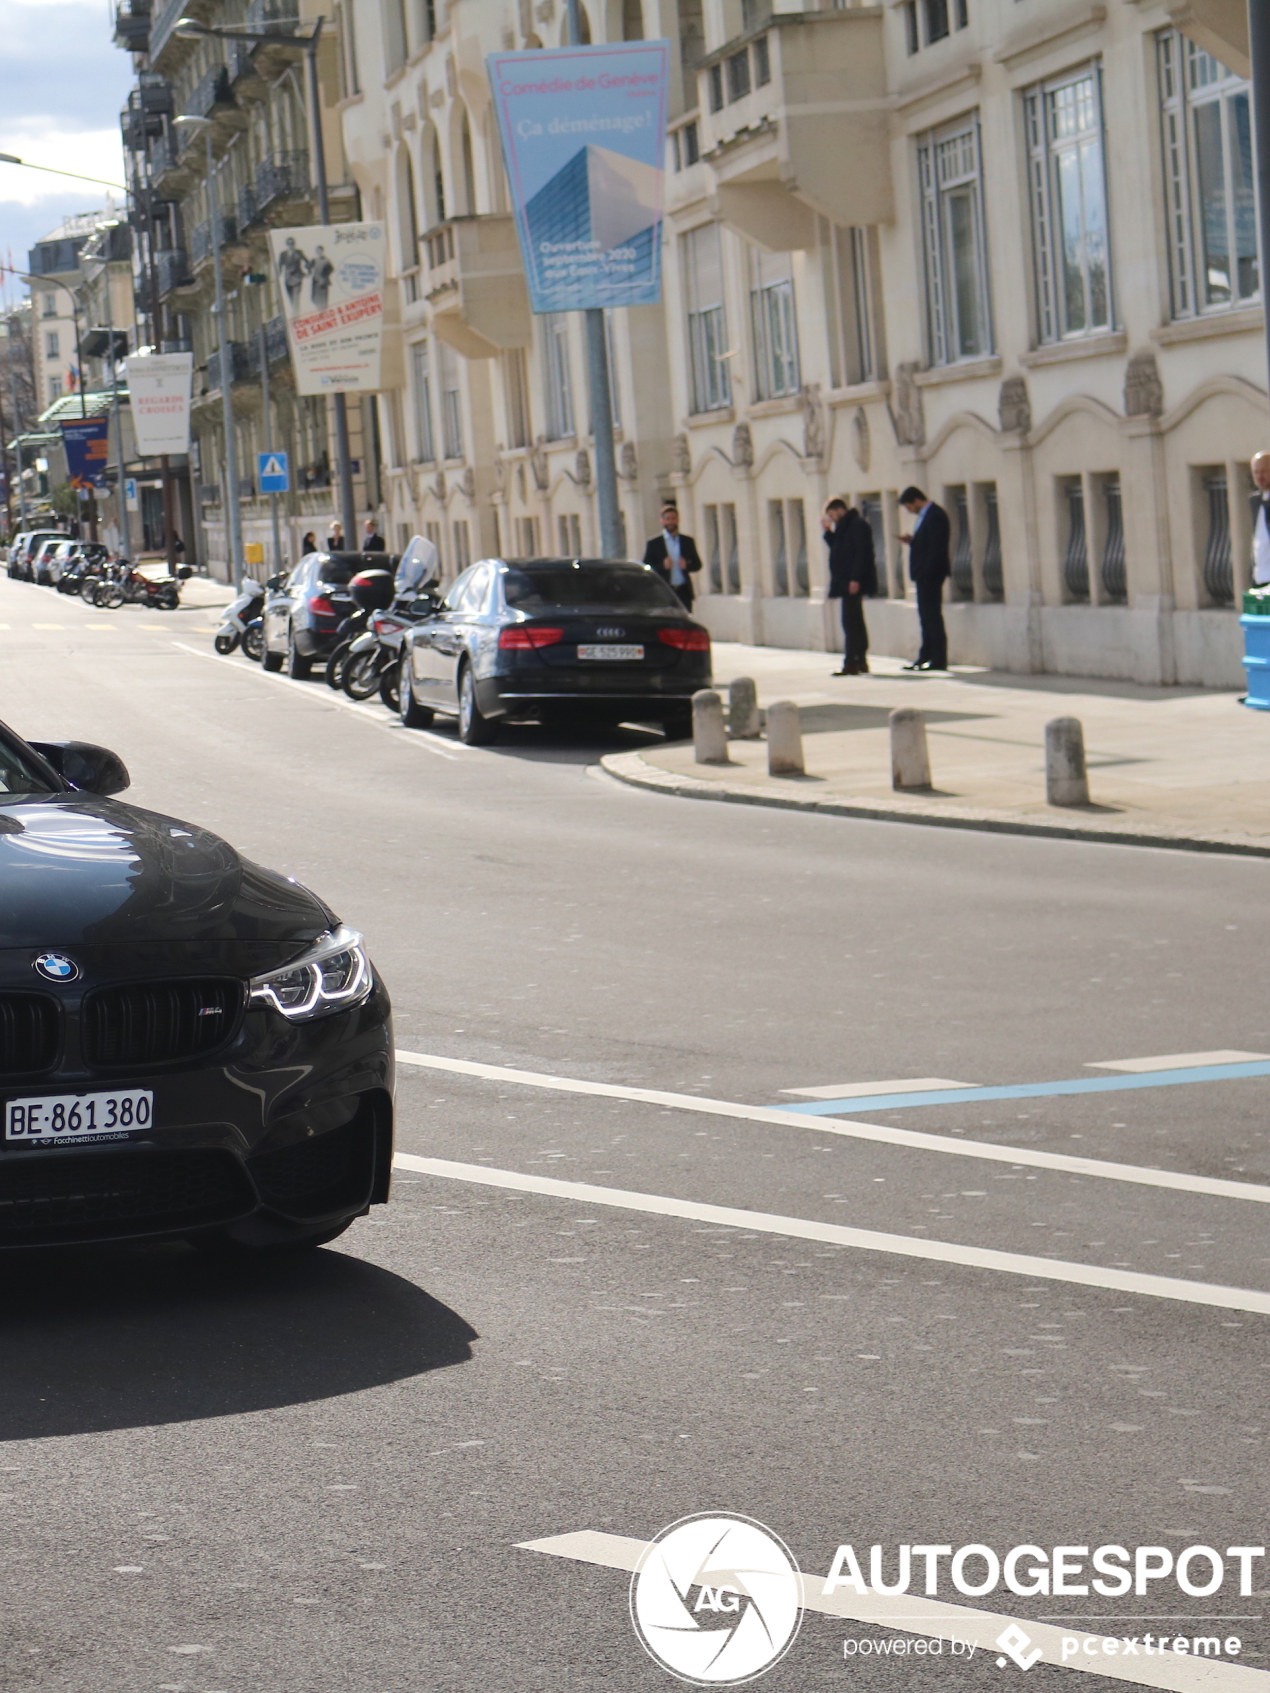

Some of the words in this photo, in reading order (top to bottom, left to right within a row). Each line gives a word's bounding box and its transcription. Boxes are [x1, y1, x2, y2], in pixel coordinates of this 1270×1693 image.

[499, 77, 573, 97] Comédie
[575, 76, 597, 91] de
[598, 71, 660, 89] Genève
[516, 119, 543, 142] Ça
